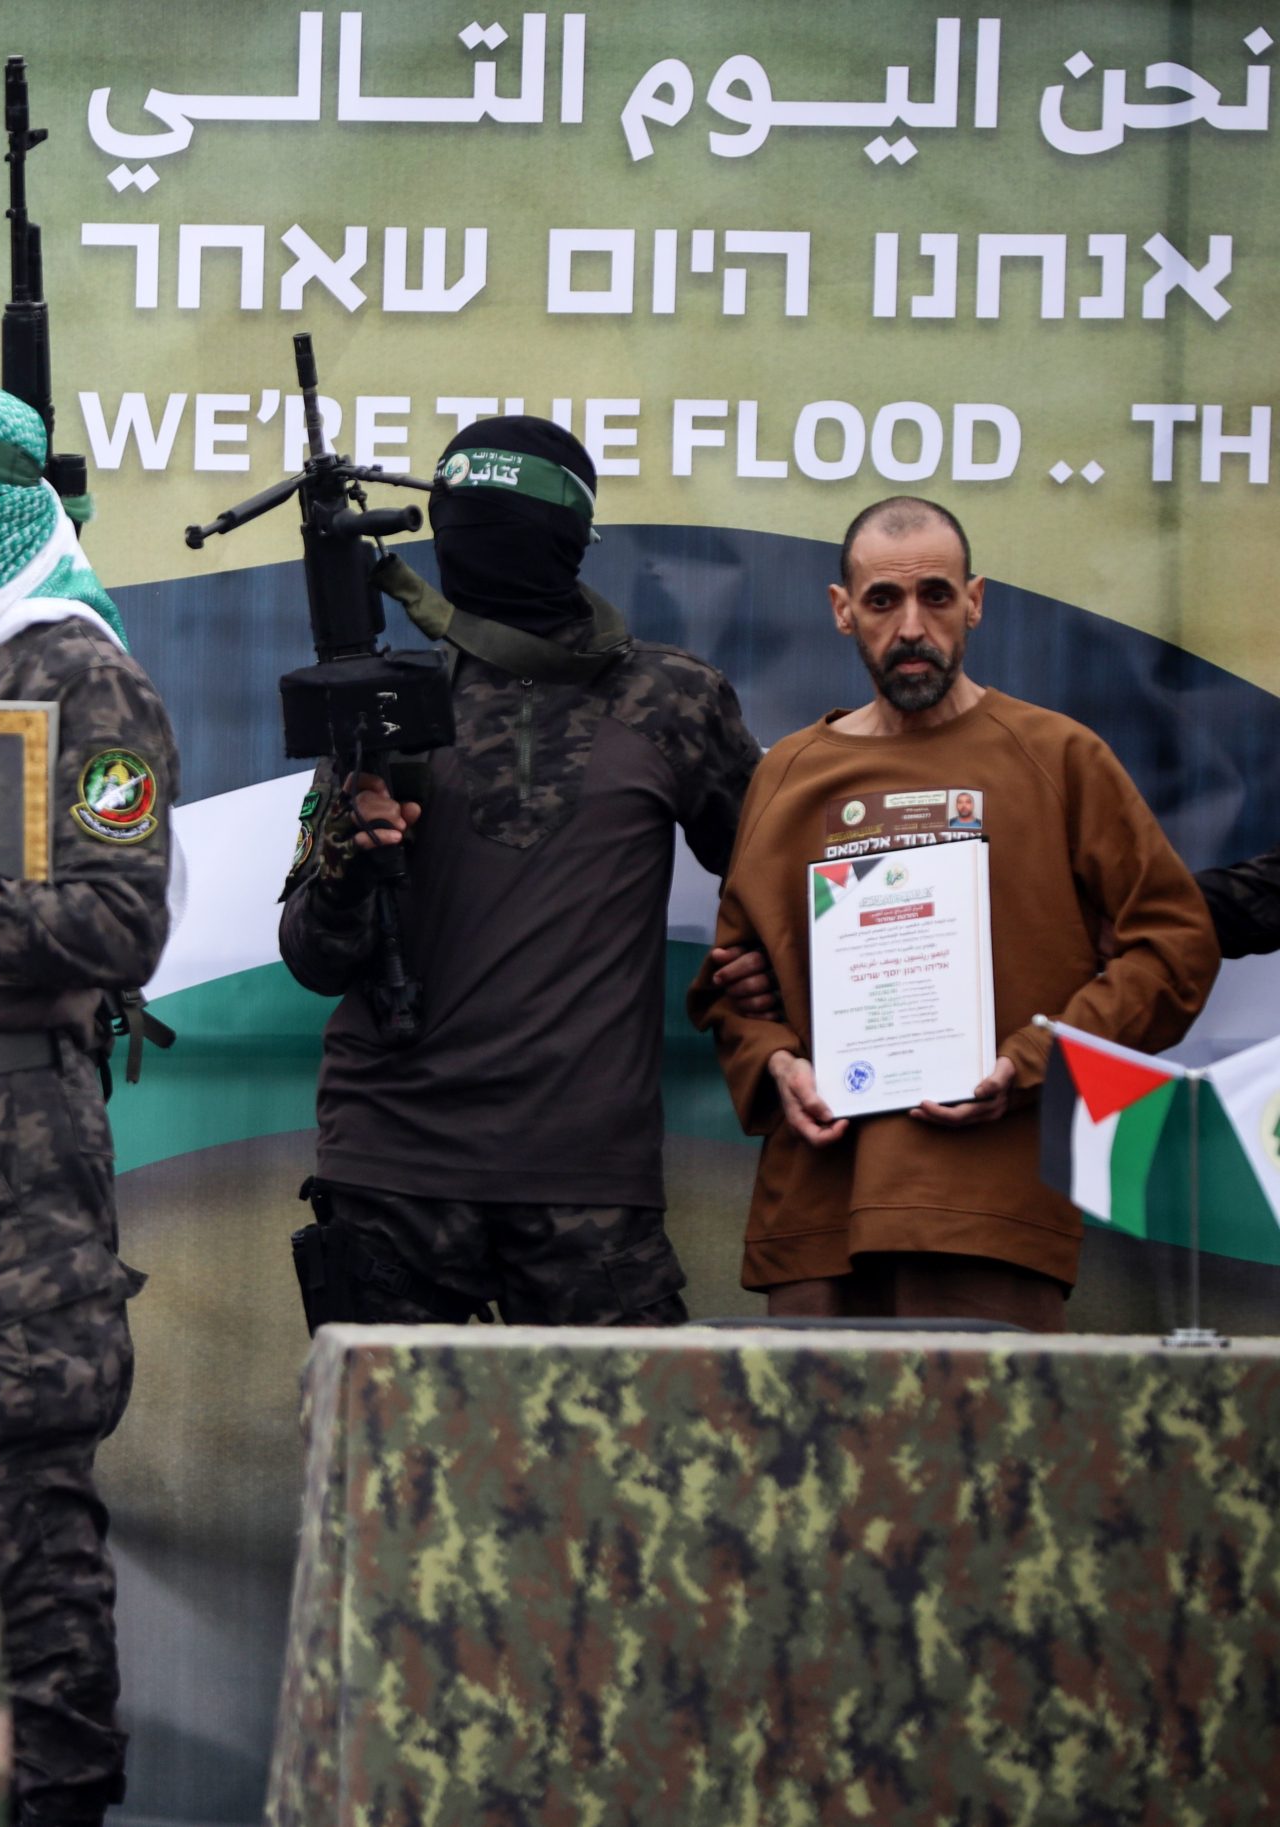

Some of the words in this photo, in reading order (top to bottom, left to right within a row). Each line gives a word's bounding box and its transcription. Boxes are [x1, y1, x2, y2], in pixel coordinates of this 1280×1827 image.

[87, 11, 586, 193] التالي
[620, 18, 1000, 165] اليوم
[1040, 27, 1273, 155] نحن
[547, 228, 811, 317] היום
[873, 232, 1232, 321] אנחנו
[435, 396, 641, 476] TE
[671, 398, 1022, 482] FLOOD
[1131, 403, 1271, 484] TH
[469, 461, 520, 486] كتائب
